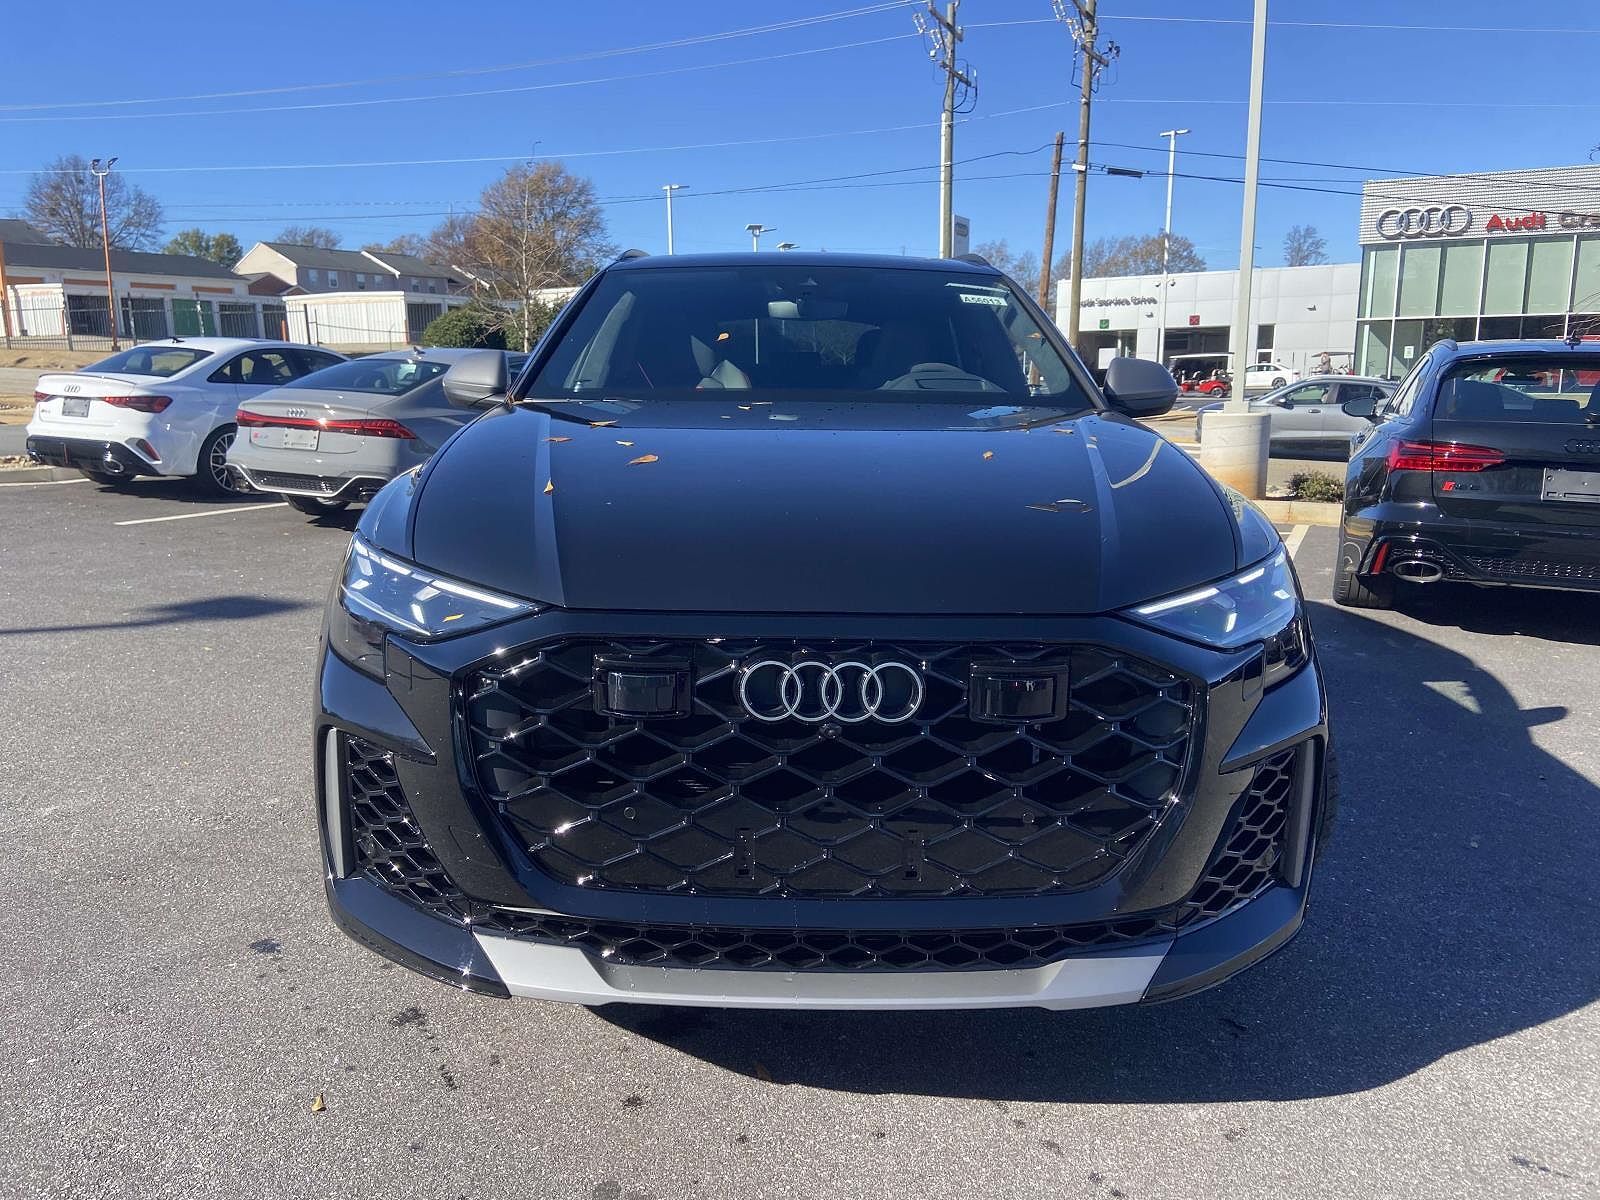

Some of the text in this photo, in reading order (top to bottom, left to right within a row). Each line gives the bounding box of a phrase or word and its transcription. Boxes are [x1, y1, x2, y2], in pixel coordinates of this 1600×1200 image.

[1487, 211, 1545, 232] Audi
[1095, 296, 1130, 307] Service
[1131, 295, 1158, 306] Drive
